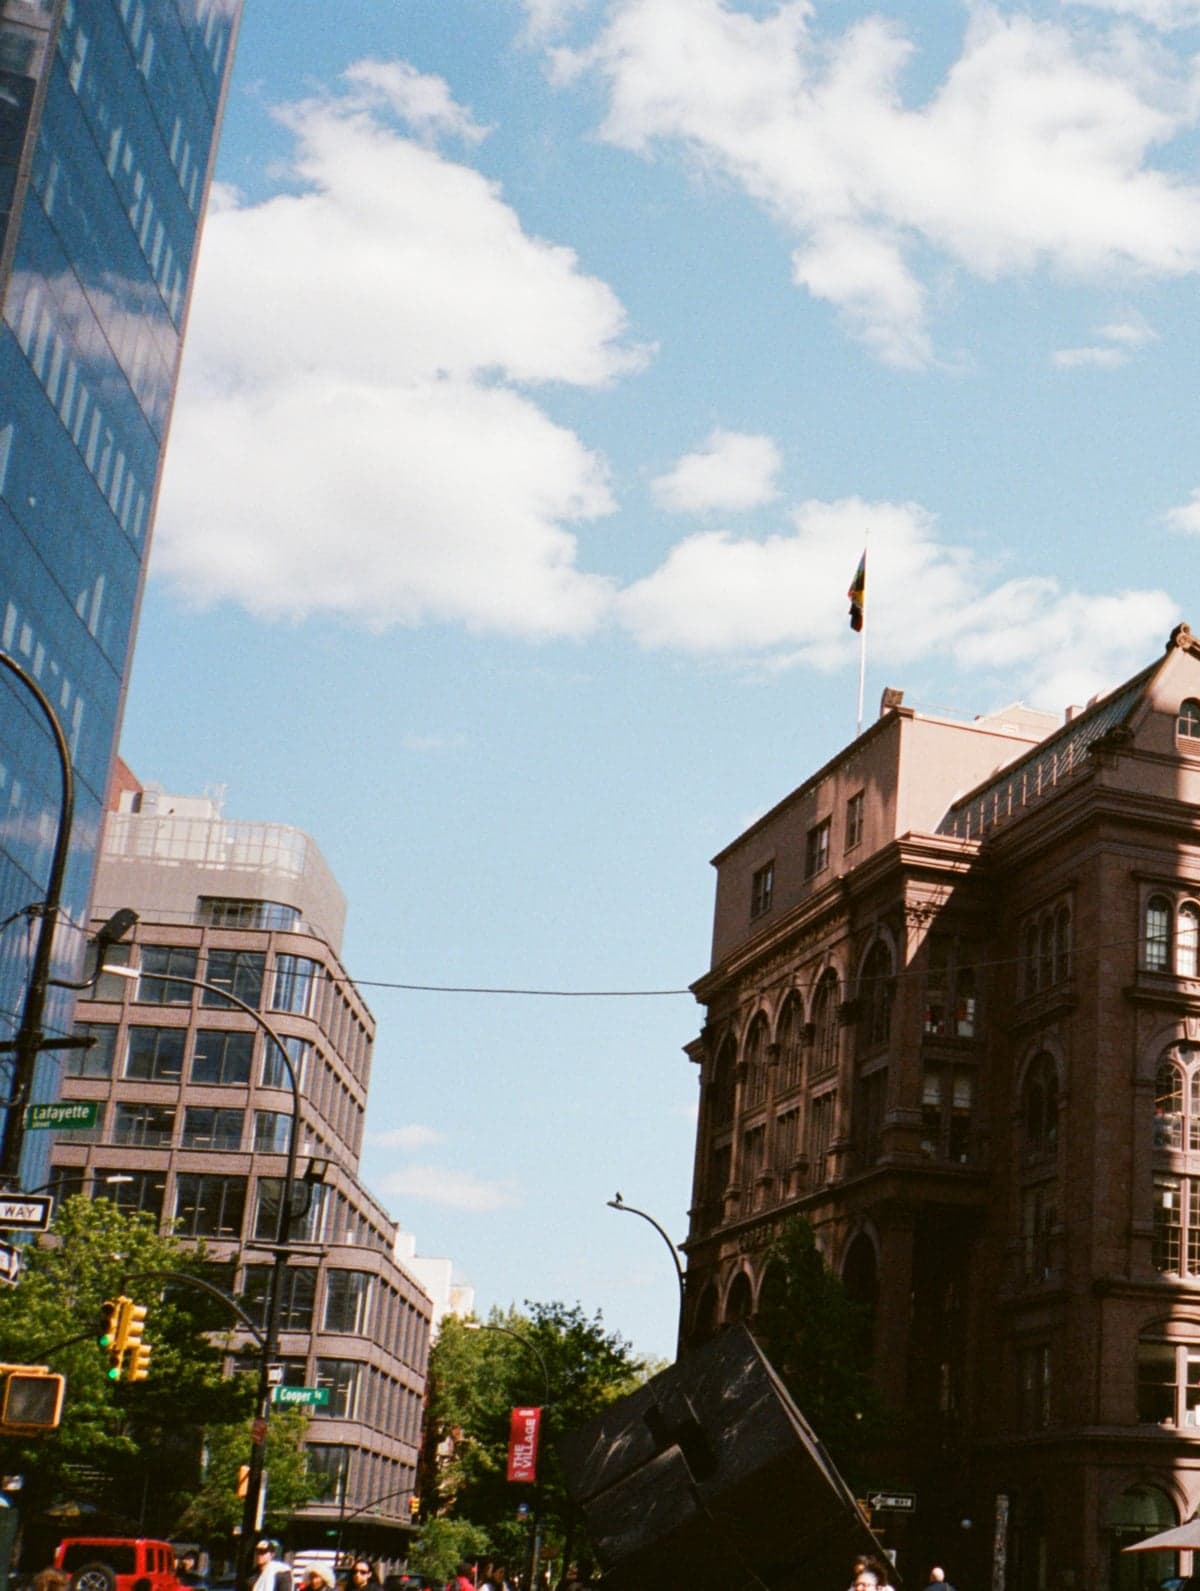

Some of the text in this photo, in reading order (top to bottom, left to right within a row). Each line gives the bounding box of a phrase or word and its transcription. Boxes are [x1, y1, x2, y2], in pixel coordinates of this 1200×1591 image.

[33, 1106, 90, 1122] Lafayette
[4, 1205, 36, 1217] WAY
[280, 1388, 312, 1403] Cooper
[521, 1418, 536, 1469] VILLAGE
[513, 1444, 525, 1469] THE
